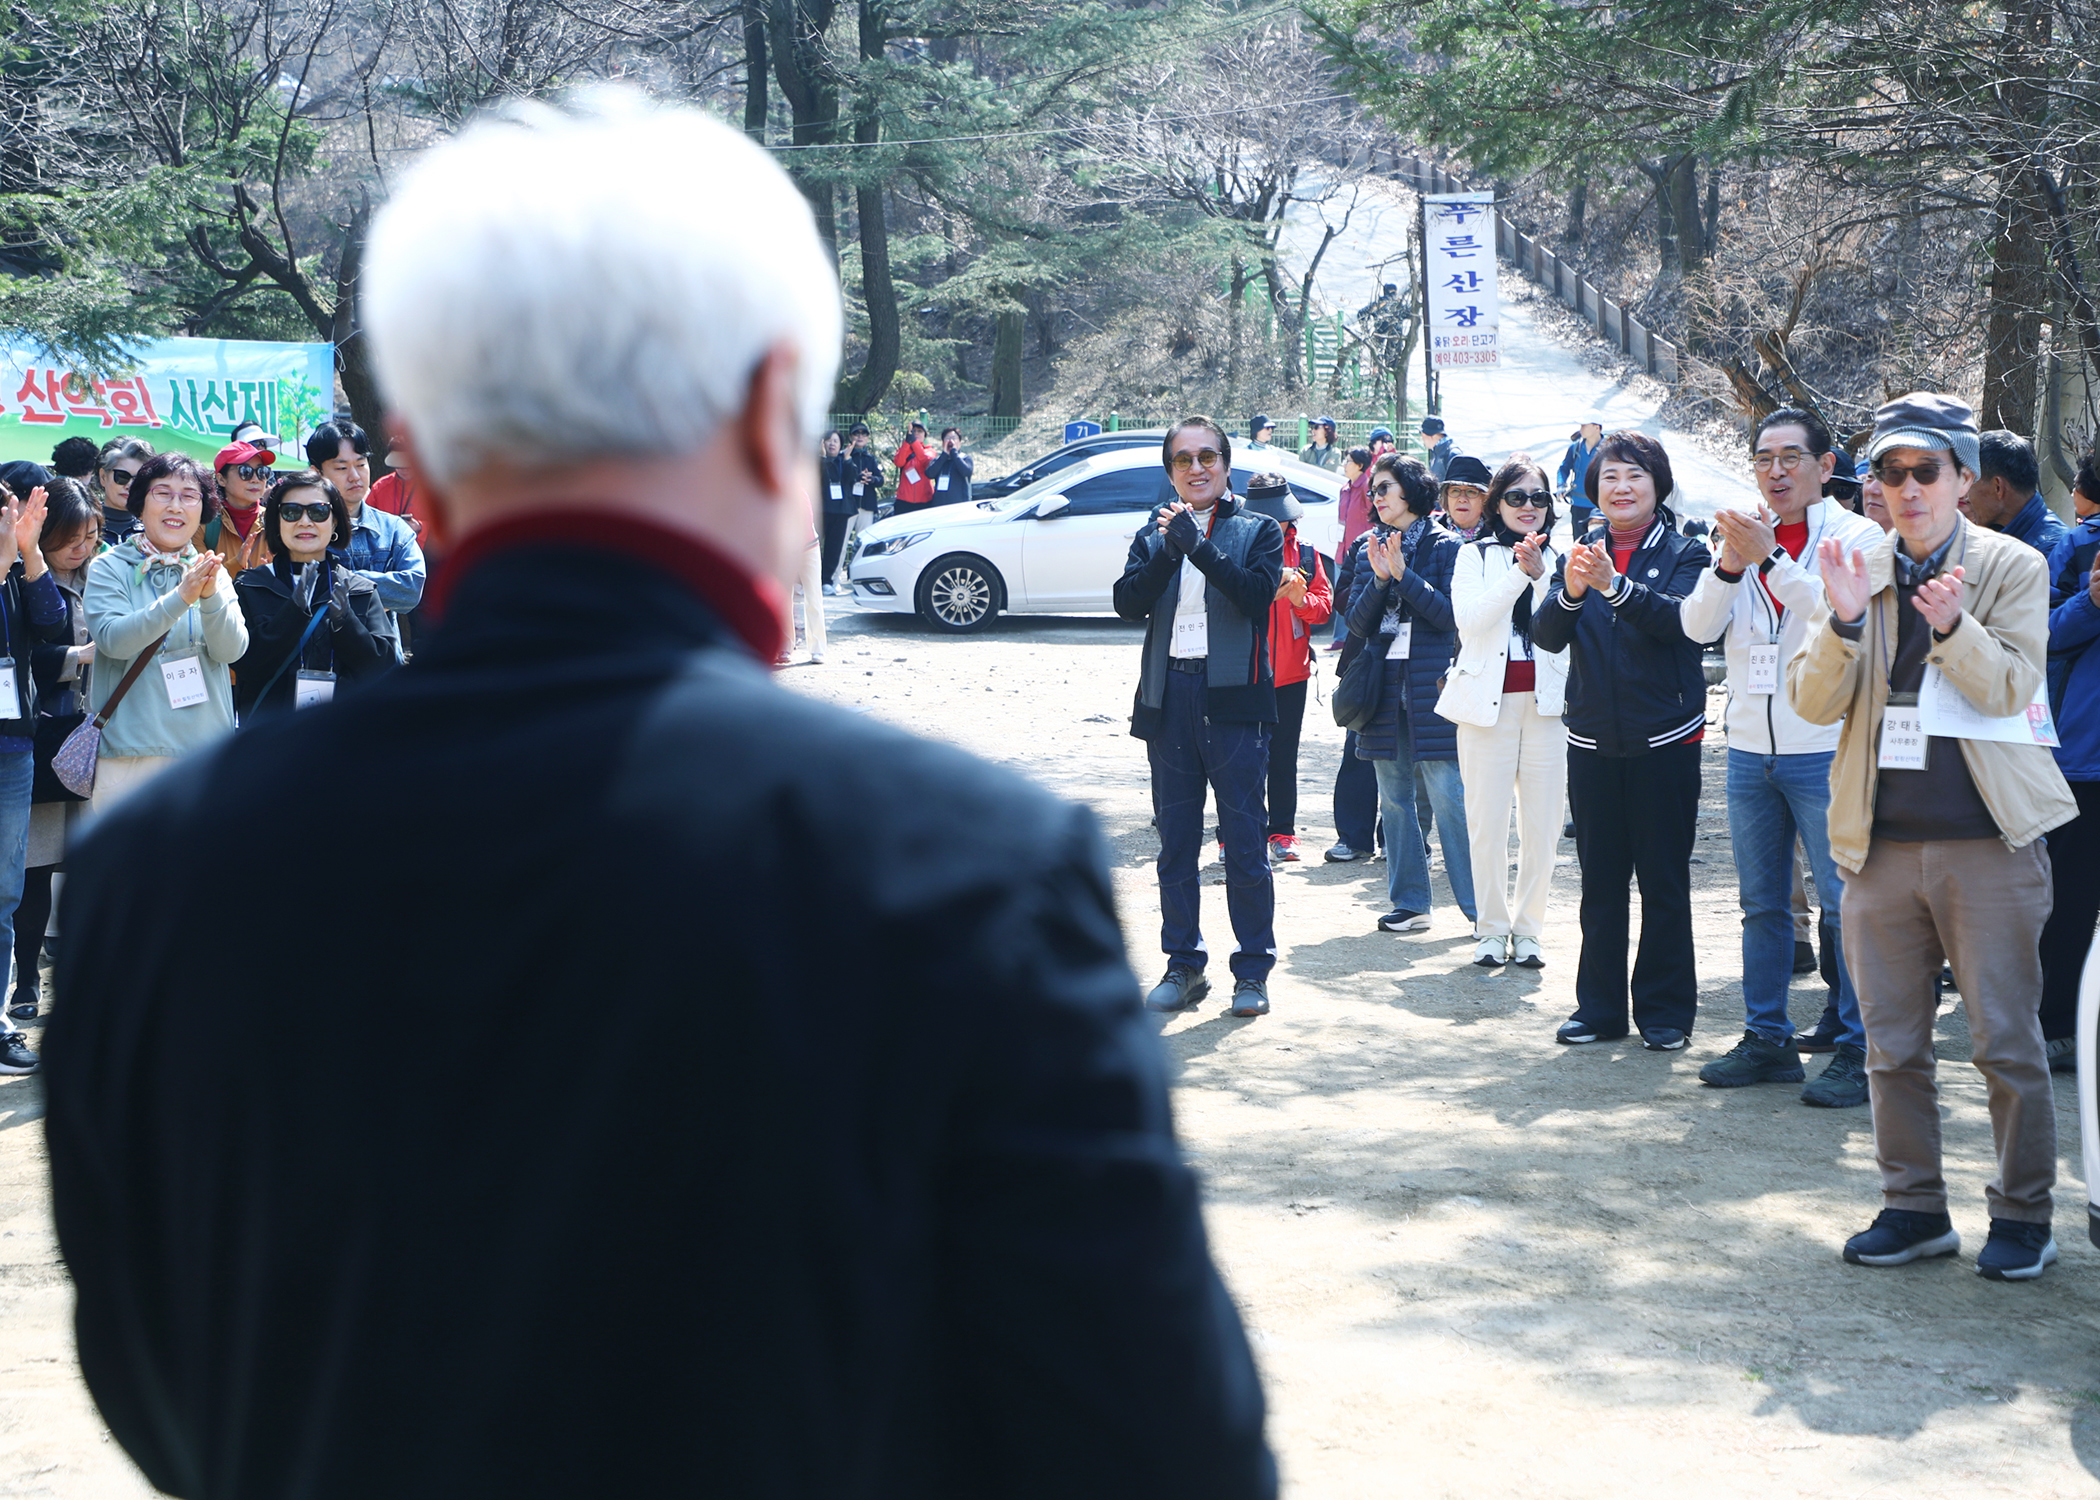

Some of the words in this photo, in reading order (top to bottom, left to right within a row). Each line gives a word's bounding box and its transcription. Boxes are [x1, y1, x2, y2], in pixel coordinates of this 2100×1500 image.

[1435, 351, 1451, 366] 예약
[1453, 350, 1497, 364] 403-3305
[17, 368, 162, 428] 산악회
[169, 379, 278, 435] 시산제
[1077, 425, 1089, 437] 71
